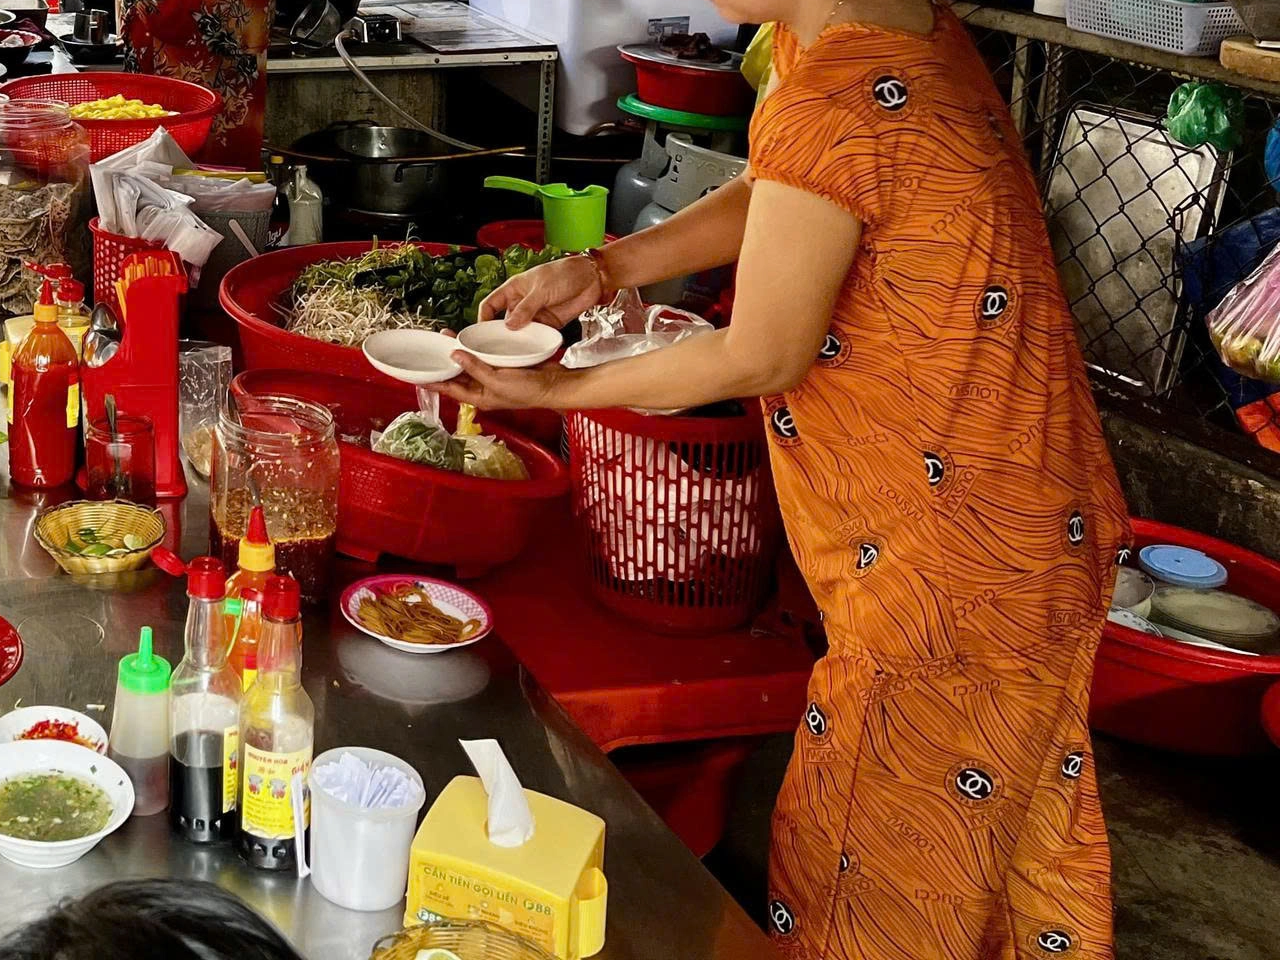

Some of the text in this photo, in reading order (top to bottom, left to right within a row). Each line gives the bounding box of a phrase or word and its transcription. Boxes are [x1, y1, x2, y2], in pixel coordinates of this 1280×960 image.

[930, 195, 973, 235] GUCCI
[846, 431, 890, 448] GUCCI
[955, 589, 997, 618] GUCC
[952, 678, 1001, 696] GUCCI
[914, 888, 964, 906] GUCCI
